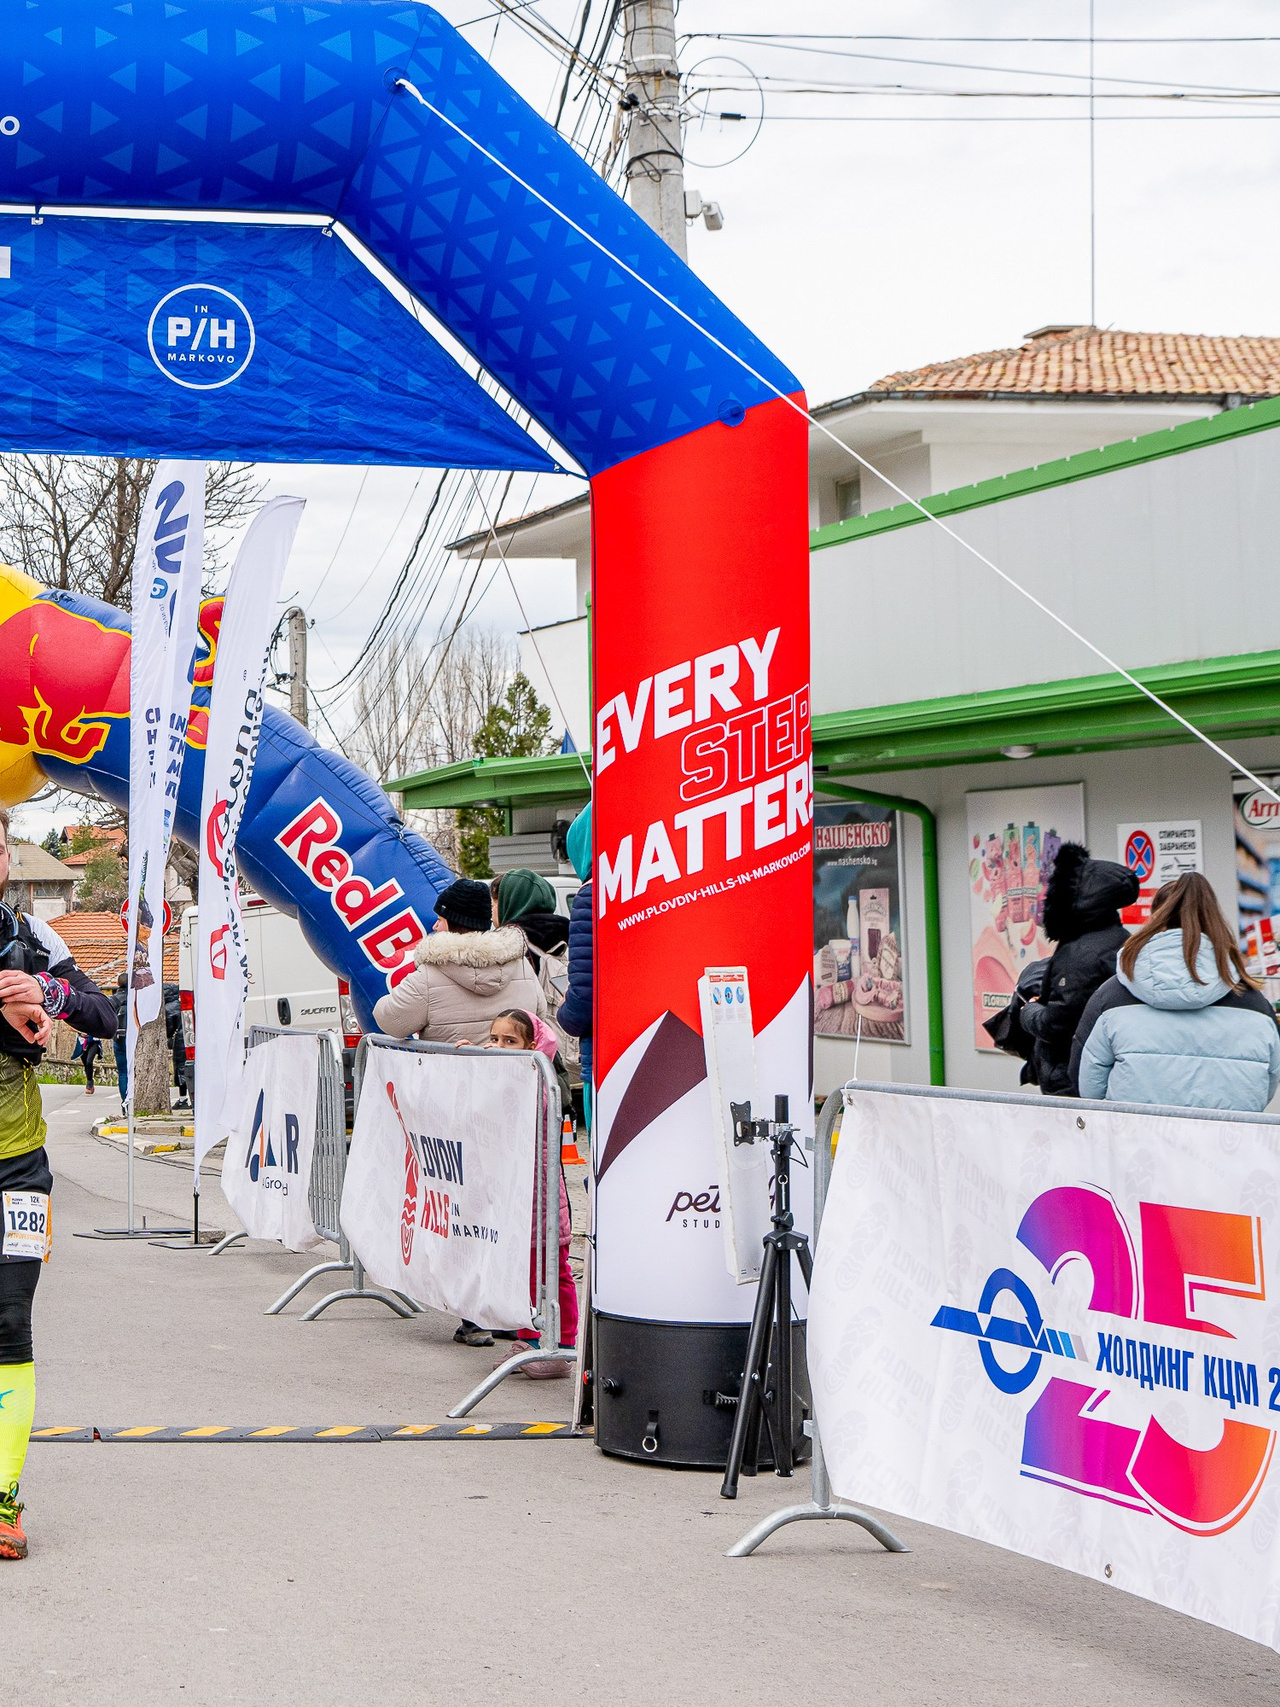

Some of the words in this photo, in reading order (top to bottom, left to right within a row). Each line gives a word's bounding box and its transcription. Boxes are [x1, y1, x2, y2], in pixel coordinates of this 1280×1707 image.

[194, 305, 208, 313] IN
[167, 316, 236, 351] P/H
[167, 353, 235, 364] MARKOVO
[596, 627, 781, 777] EVERY
[679, 683, 810, 802] STEP
[815, 822, 890, 849] НАШЕНСКО
[280, 802, 399, 926] Red
[618, 841, 811, 931] WWW.PLOVDIV-HILLS-IN-MARKOVO.COM
[300, 1006, 336, 1016] DUCATO
[410, 1132, 464, 1186] OVDIV
[8, 1210, 45, 1234] 1282
[451, 1202, 461, 1217] IN
[682, 1219, 720, 1228] STUD
[1095, 1332, 1194, 1391] ХОЛДИНГ
[1203, 1354, 1259, 1410] КЦМ
